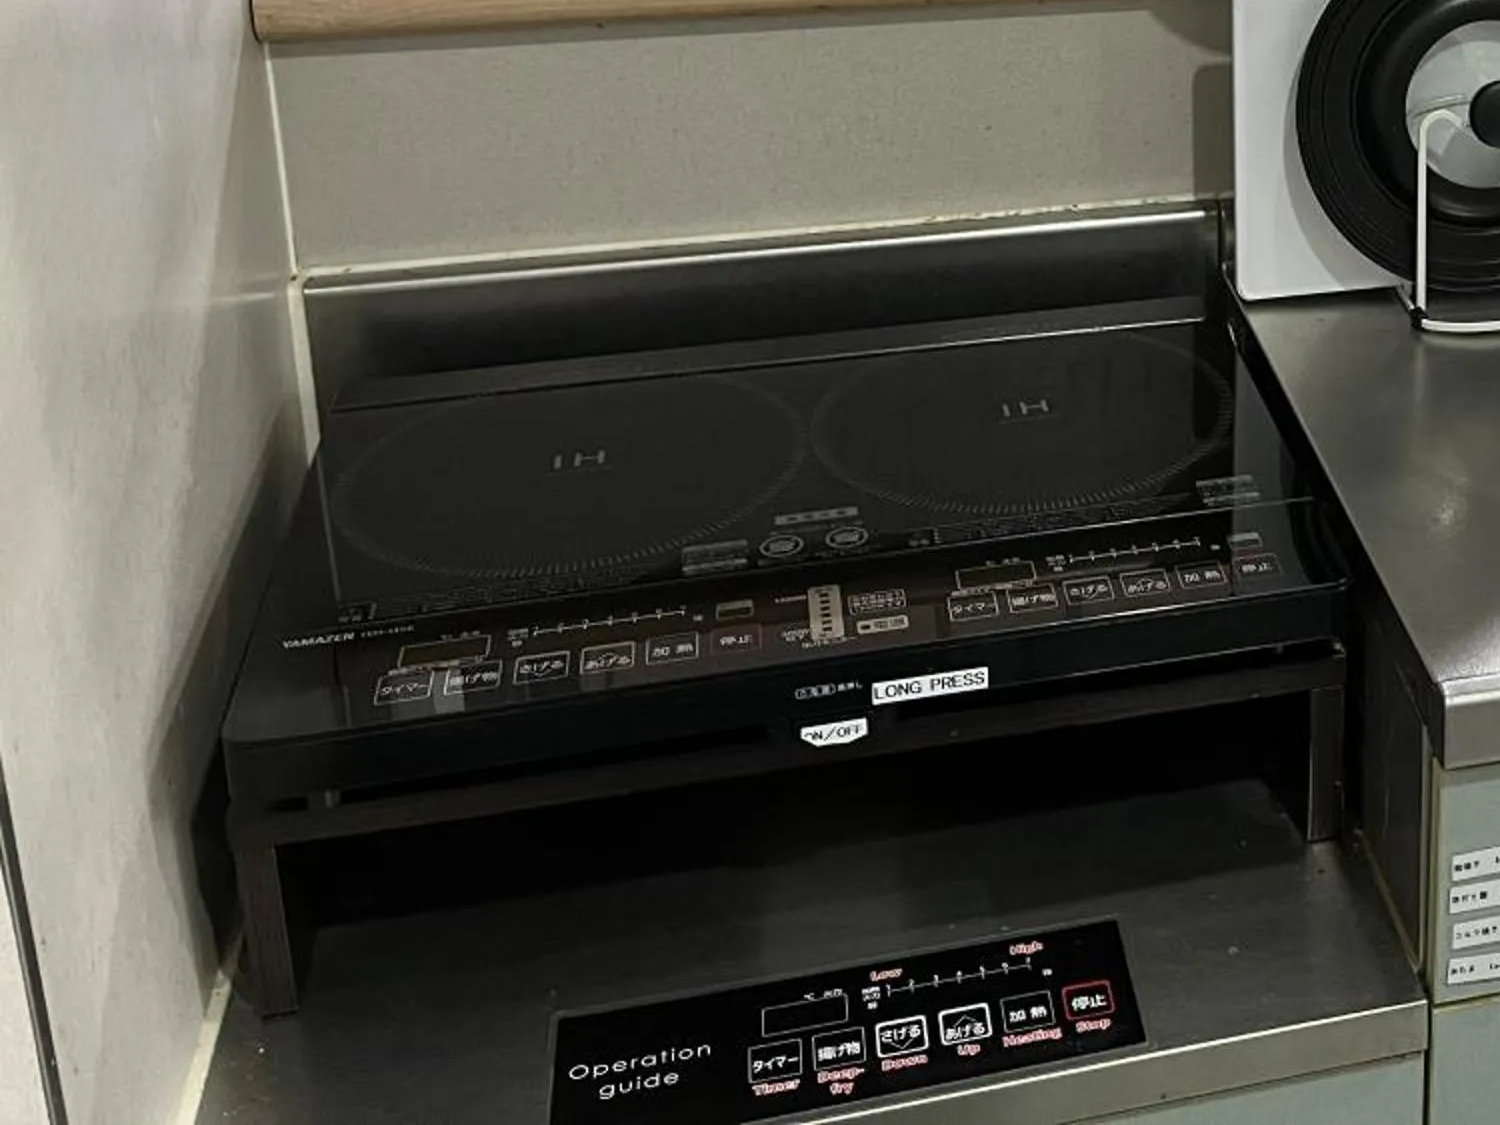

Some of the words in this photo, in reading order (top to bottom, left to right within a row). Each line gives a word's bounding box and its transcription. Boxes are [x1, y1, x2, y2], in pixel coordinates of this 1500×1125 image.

[873, 681, 923, 700] LONG
[930, 671, 986, 691] PRESS
[1071, 993, 1108, 1012] 停止
[879, 1025, 921, 1043] さげる
[945, 1022, 986, 1041] あげる
[569, 1044, 711, 1080] Operation
[752, 1055, 799, 1074] タイマー
[881, 1055, 929, 1072] Down
[599, 1073, 679, 1100] guide
